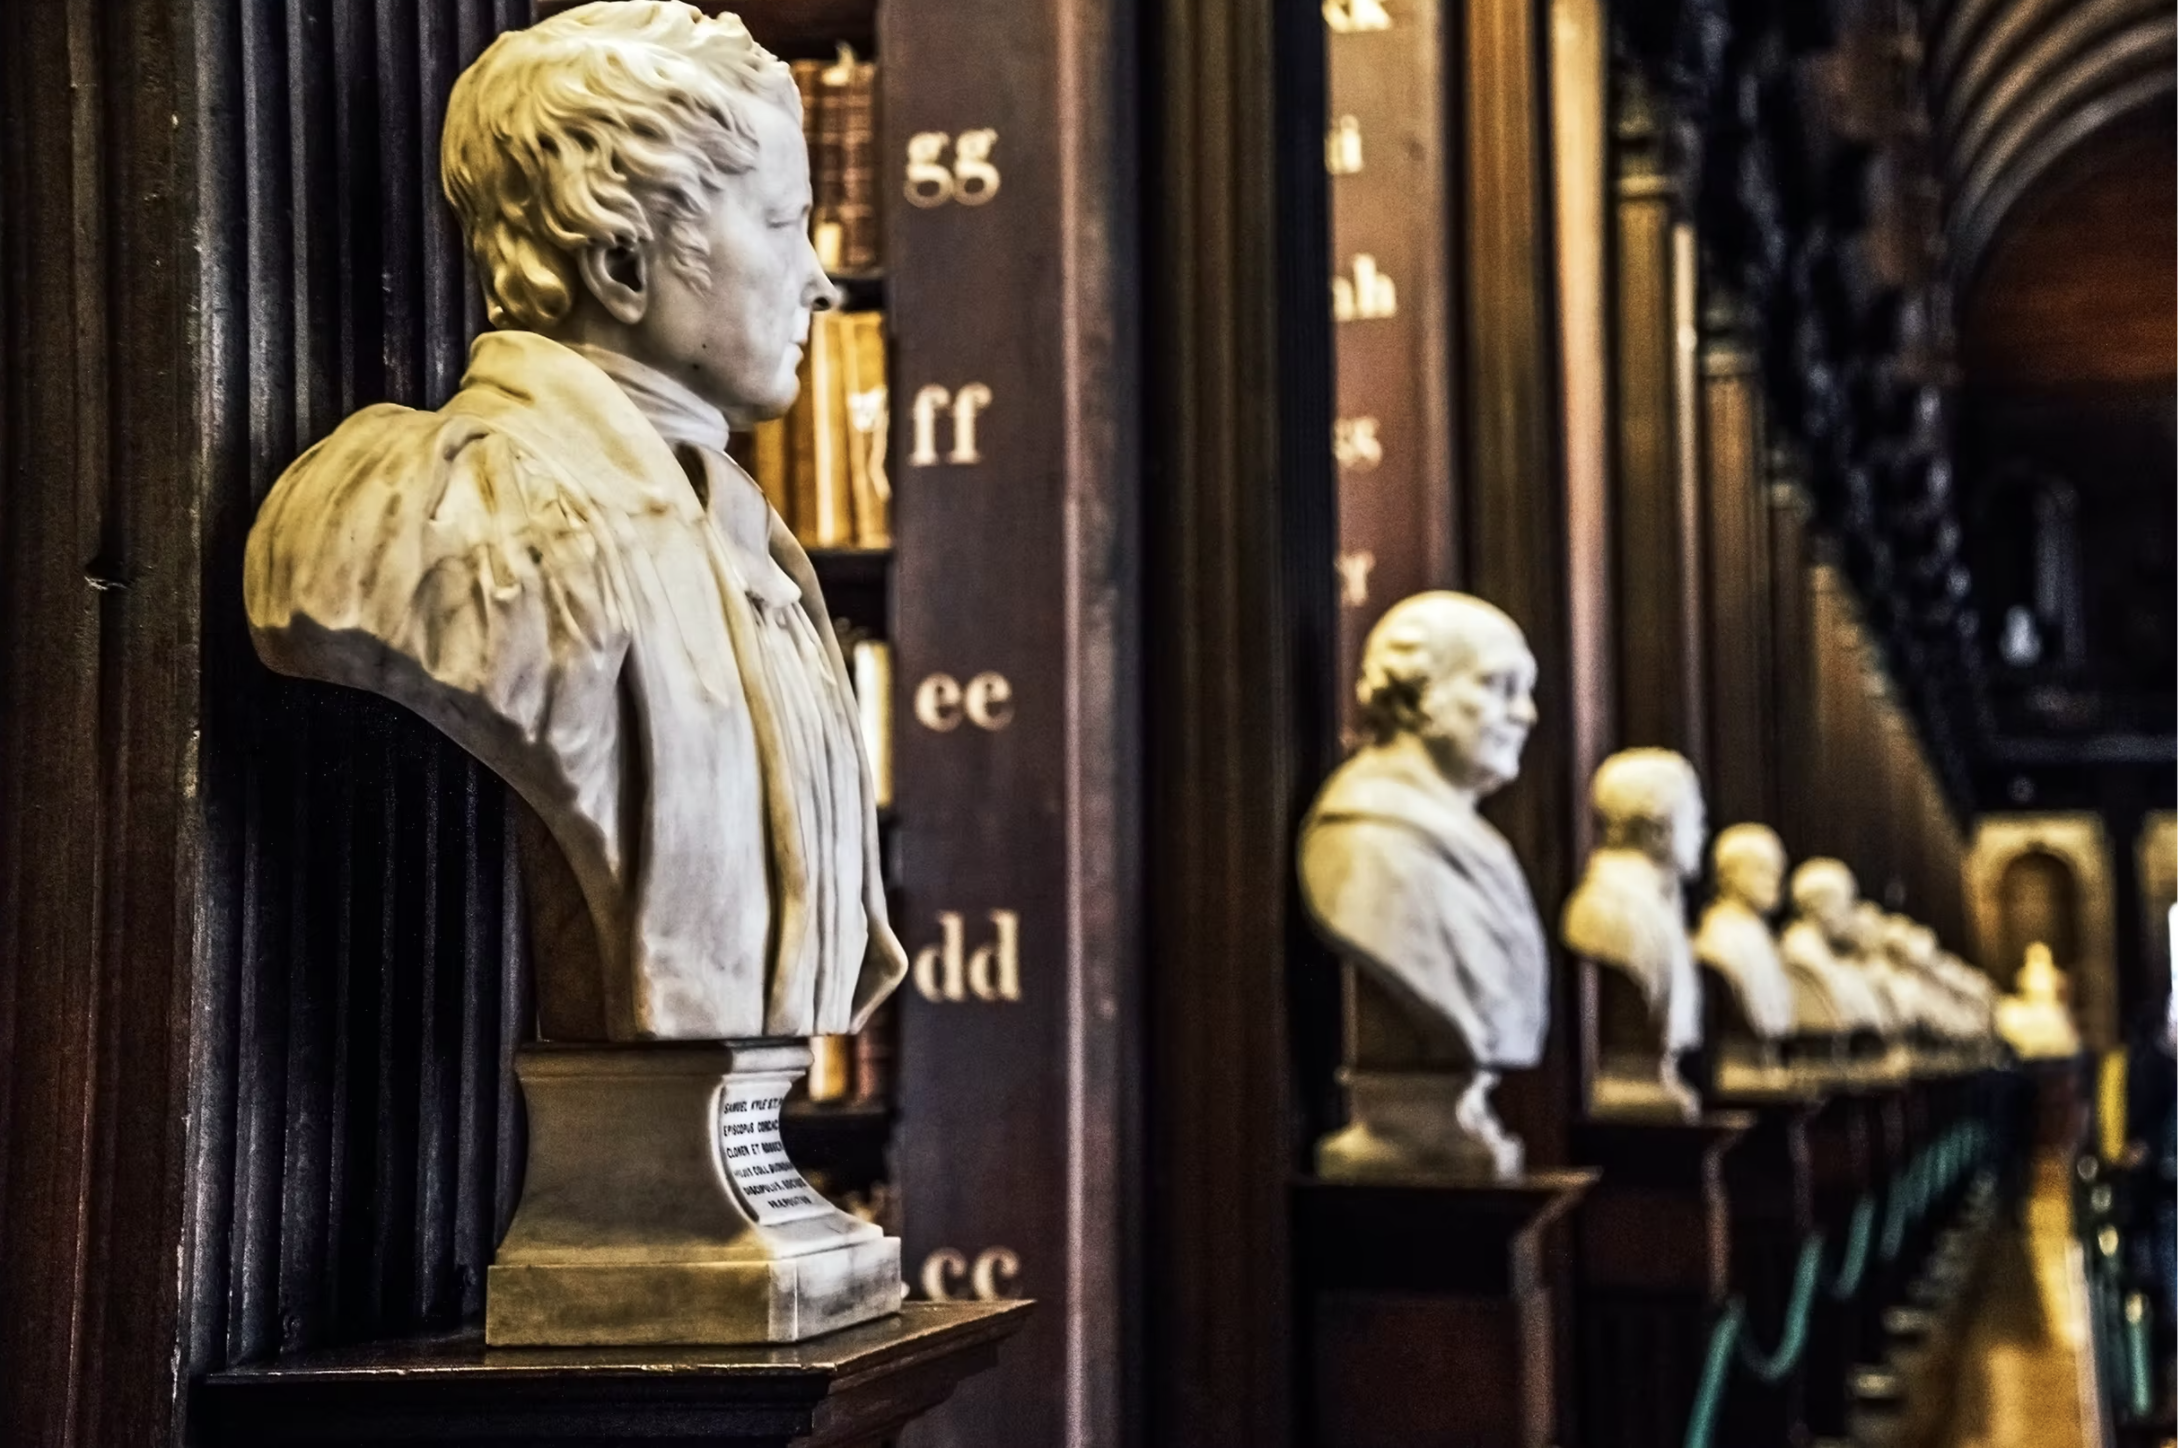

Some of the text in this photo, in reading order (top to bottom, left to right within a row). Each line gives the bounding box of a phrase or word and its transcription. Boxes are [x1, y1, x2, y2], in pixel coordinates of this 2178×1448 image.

[905, 127, 1000, 206] gg
[909, 383, 992, 467] ff
[914, 671, 1014, 732] ee
[914, 910, 1021, 1002] dd
[723, 1122, 754, 1137] EPISCOPUS
[724, 1101, 747, 1114] SAMUEL
[751, 1143, 760, 1155] ET
[921, 1246, 1020, 1300] cc
